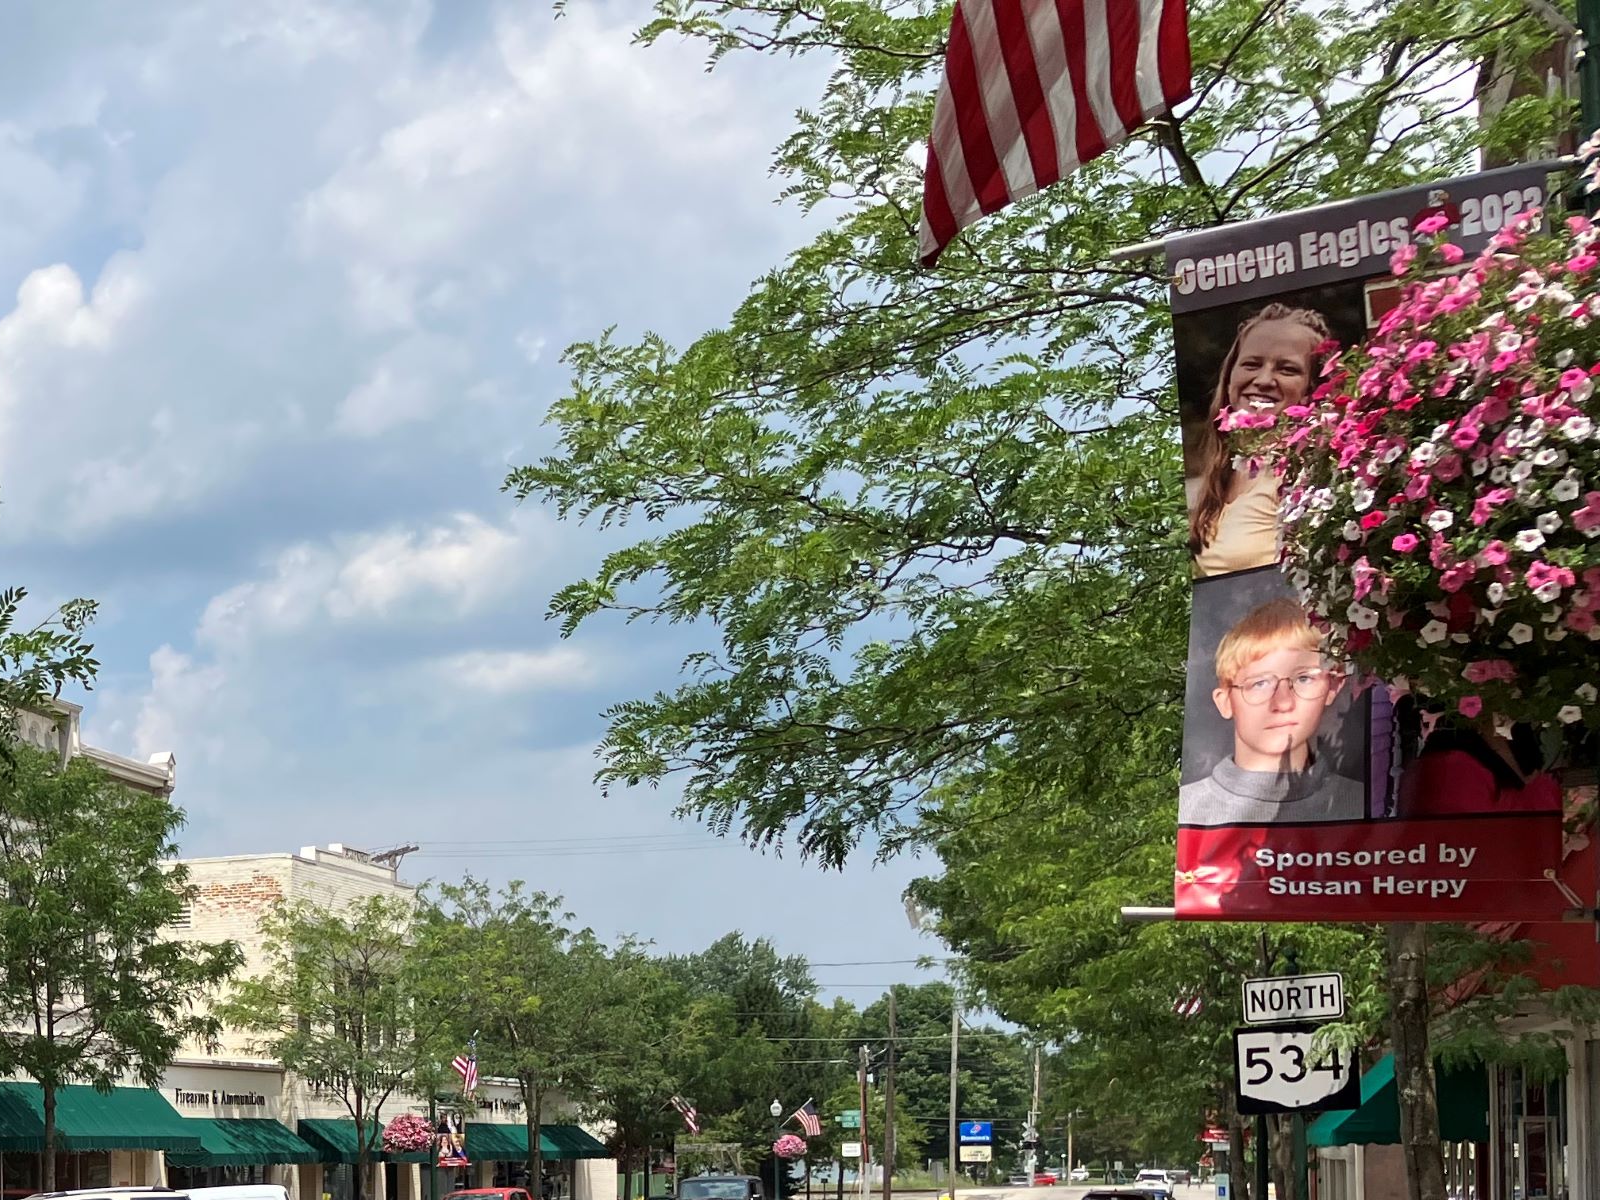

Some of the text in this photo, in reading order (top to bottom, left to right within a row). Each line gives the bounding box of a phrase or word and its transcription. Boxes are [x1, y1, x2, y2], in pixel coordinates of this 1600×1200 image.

[1174, 240, 1295, 296] Geneva
[1299, 216, 1410, 269] Eagles
[1255, 843, 1477, 871] Sponsored by
[1268, 876, 1467, 898] Susan Herpy
[1250, 984, 1335, 1013] NORTH
[1246, 1044, 1343, 1085] 534
[175, 1088, 265, 1106] Firearms & Ammunition
